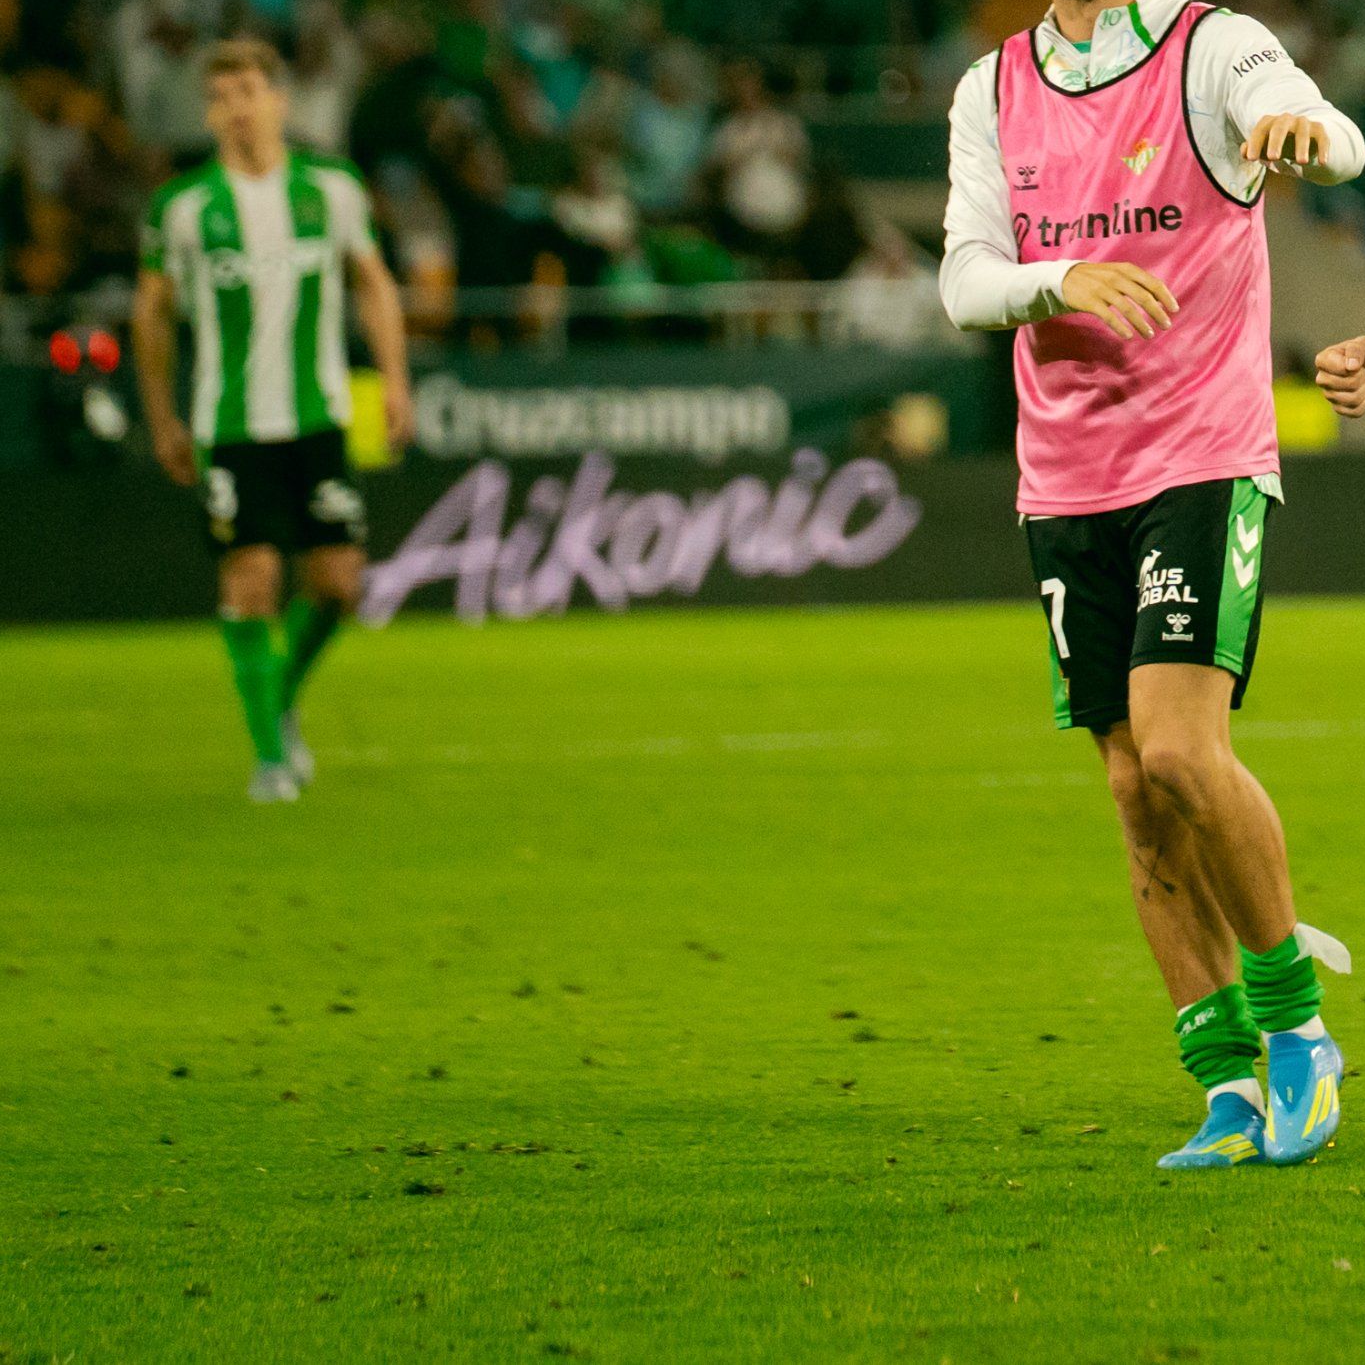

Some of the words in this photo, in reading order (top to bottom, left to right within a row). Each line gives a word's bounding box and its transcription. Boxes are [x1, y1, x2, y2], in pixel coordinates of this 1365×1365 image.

[1232, 49, 1288, 78] kingr
[1038, 200, 1183, 247] trnline
[1143, 568, 1184, 591] AUS
[1137, 585, 1199, 613] OBAL
[1041, 577, 1071, 659] 7
